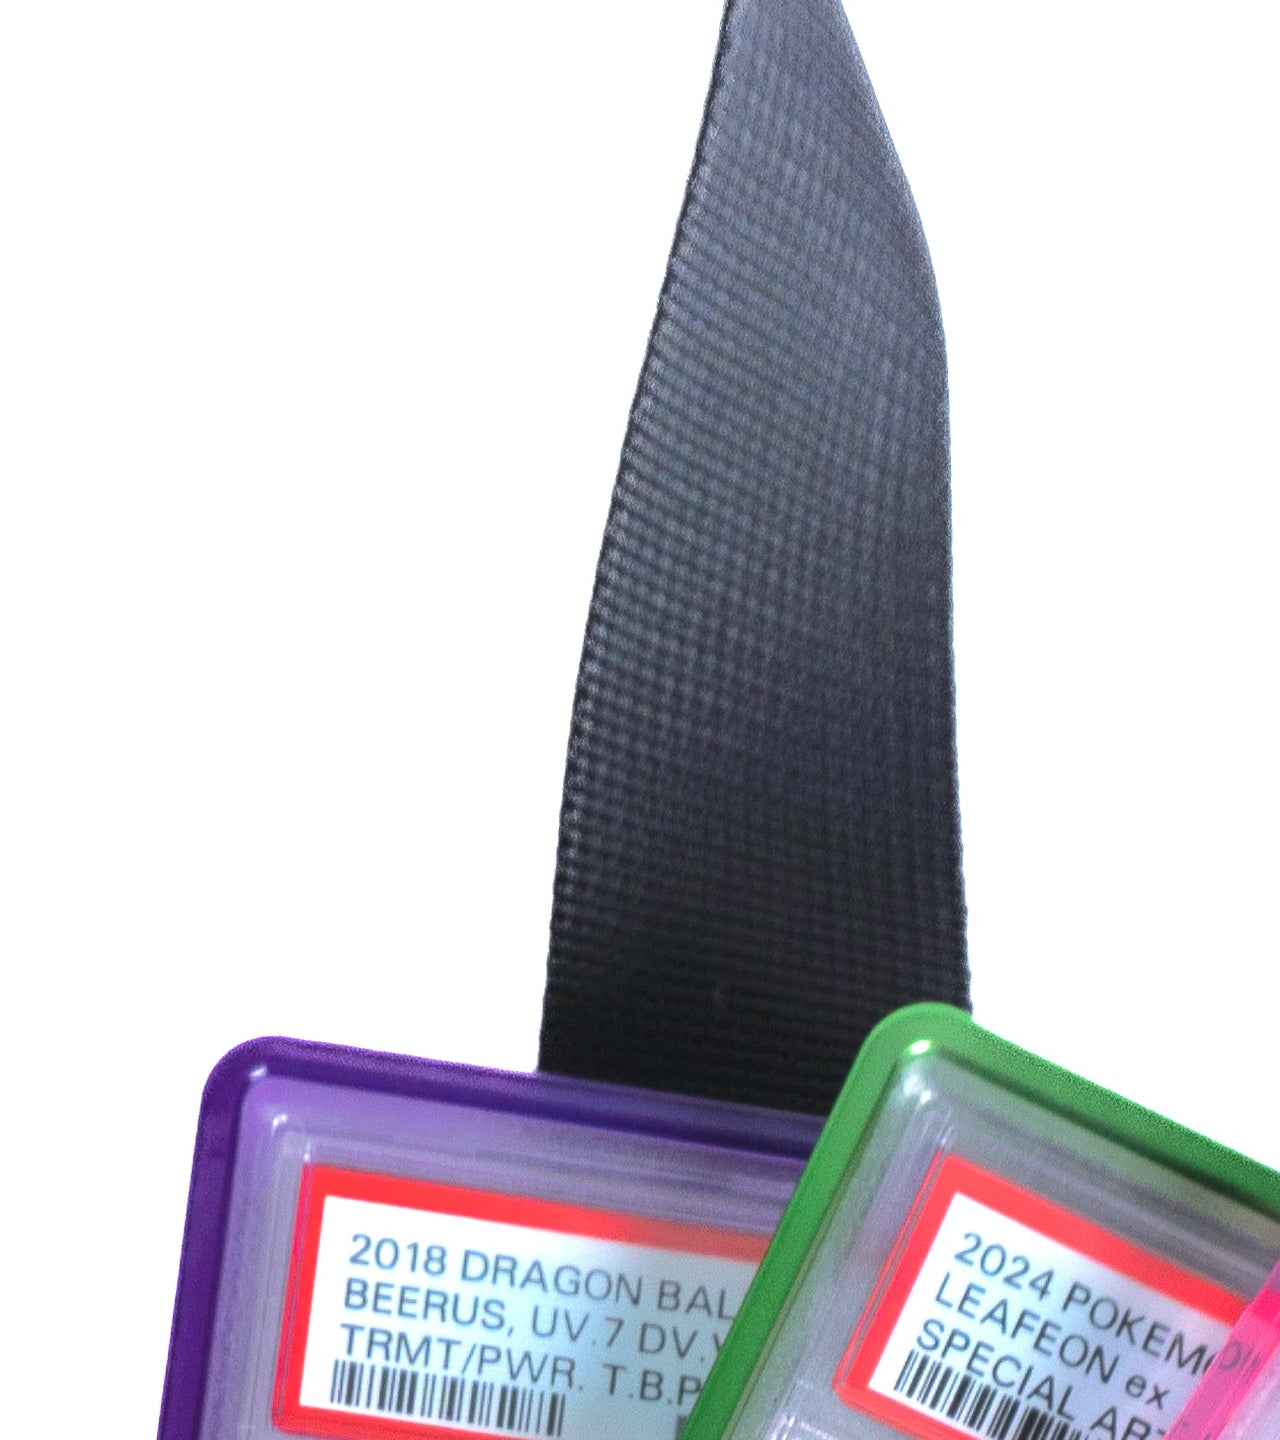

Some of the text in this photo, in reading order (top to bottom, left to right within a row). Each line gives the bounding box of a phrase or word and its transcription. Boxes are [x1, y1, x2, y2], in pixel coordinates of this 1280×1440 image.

[348, 1233, 448, 1277] 2018
[460, 1249, 643, 1307] DRAGON
[953, 1231, 1056, 1301] 2024
[344, 1276, 516, 1337] BEERUS,
[935, 1271, 1170, 1411] LEAFEON ex
[340, 1322, 584, 1392] TRMT/PWR.
[916, 1317, 1076, 1422] SPECIAL
